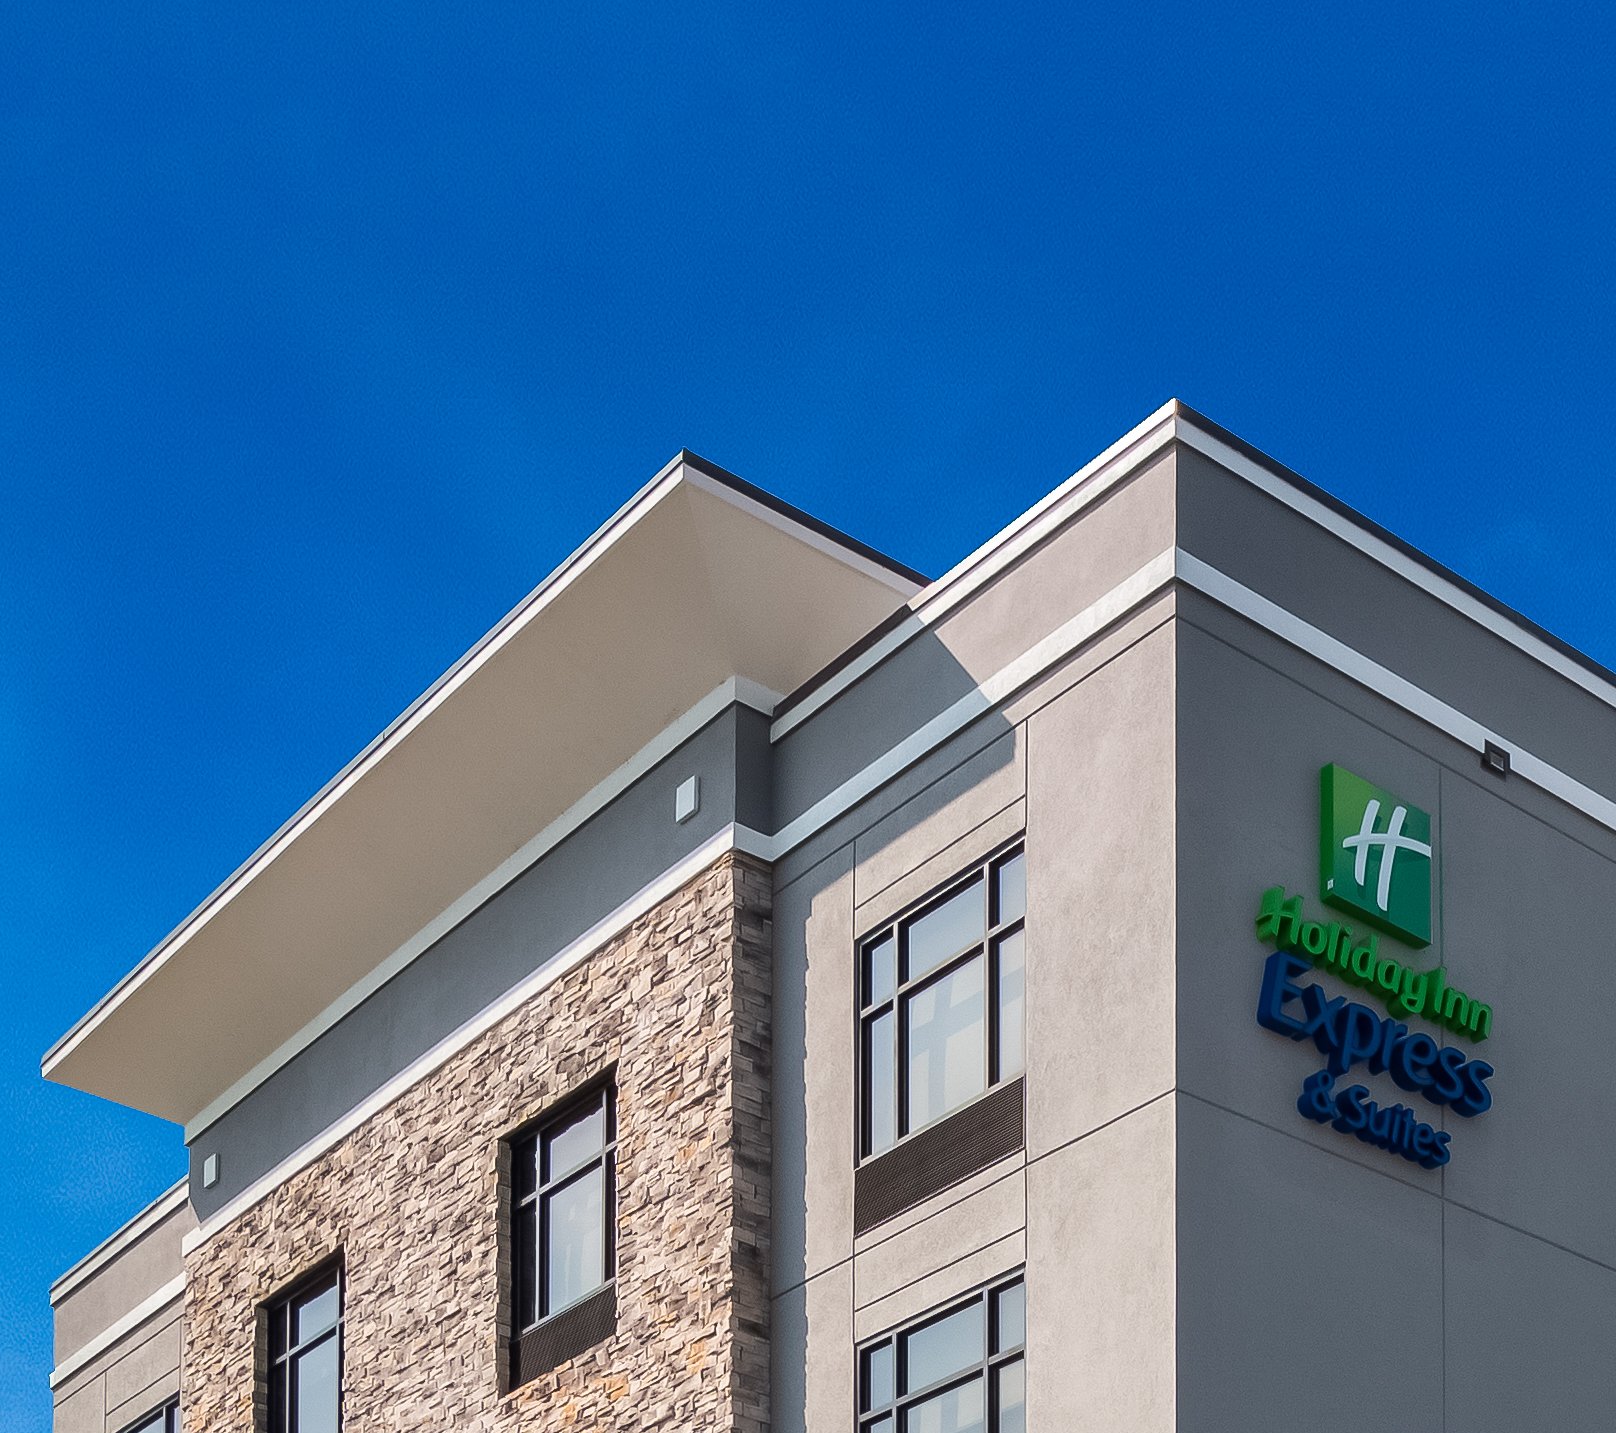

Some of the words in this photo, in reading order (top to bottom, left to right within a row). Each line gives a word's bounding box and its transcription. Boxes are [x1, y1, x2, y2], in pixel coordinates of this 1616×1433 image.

[1256, 886, 1427, 1018] Holiday
[1426, 966, 1492, 1043] Inn
[1257, 951, 1494, 1117] Express
[1297, 1069, 1337, 1124] &
[1333, 1084, 1451, 1169] Suites
